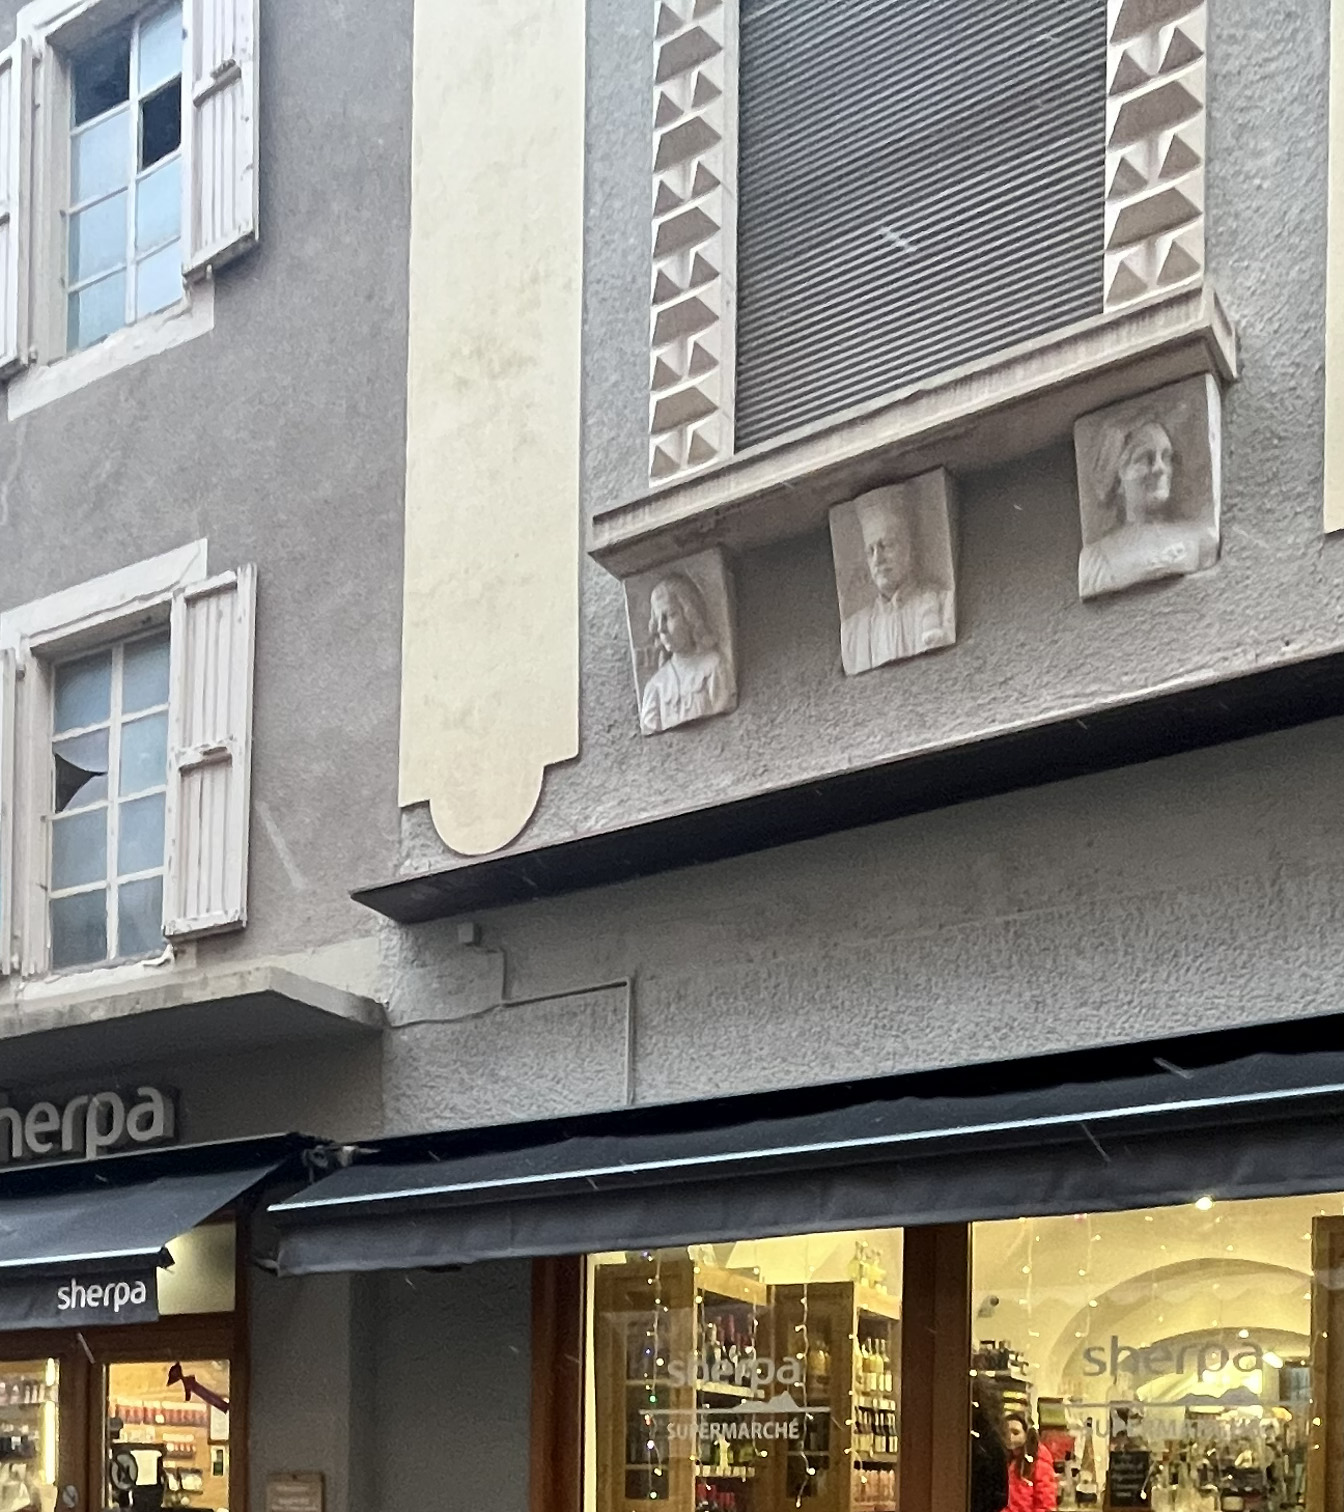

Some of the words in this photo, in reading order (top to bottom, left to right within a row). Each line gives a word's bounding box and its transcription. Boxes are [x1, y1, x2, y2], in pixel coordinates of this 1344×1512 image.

[57, 1278, 146, 1312] sherpa
[1083, 1335, 1262, 1382] sherpa
[667, 1418, 800, 1440] SUPERMARCHÉ
